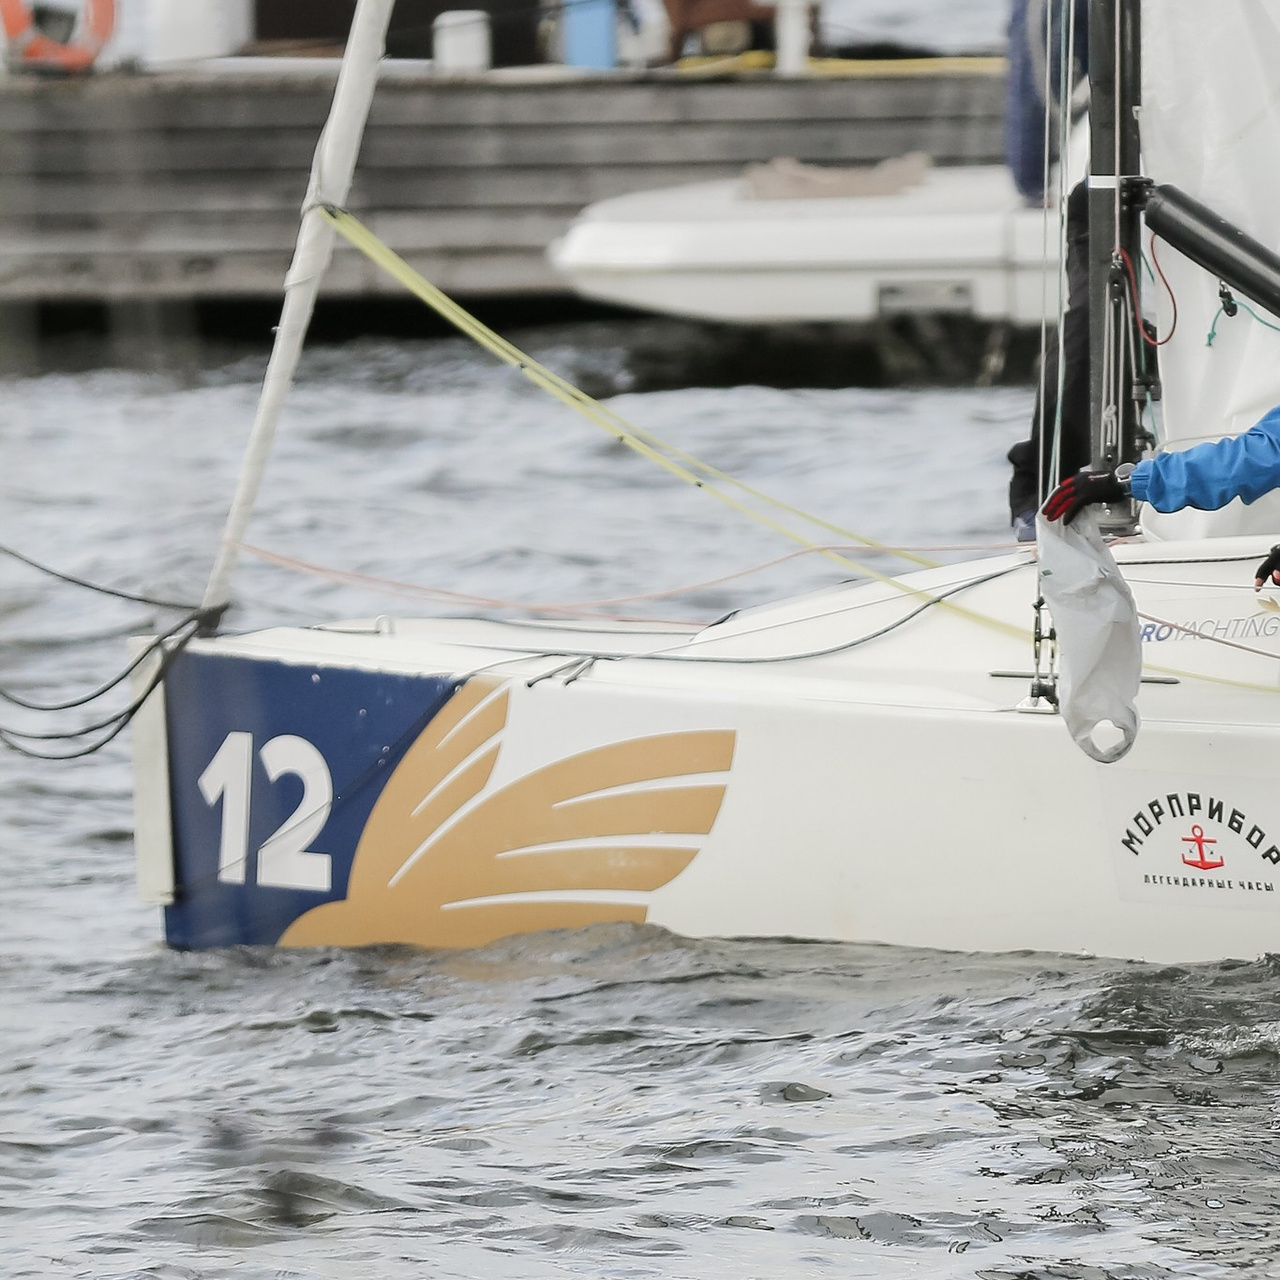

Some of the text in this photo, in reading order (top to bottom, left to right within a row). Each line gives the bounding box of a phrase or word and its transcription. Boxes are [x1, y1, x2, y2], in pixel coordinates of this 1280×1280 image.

[1139, 616, 1280, 642] ROYACHTING
[197, 730, 334, 892] 12
[1144, 874, 1275, 892] ЛЕГЕНДАРНЫЕ ЧАСЫ
